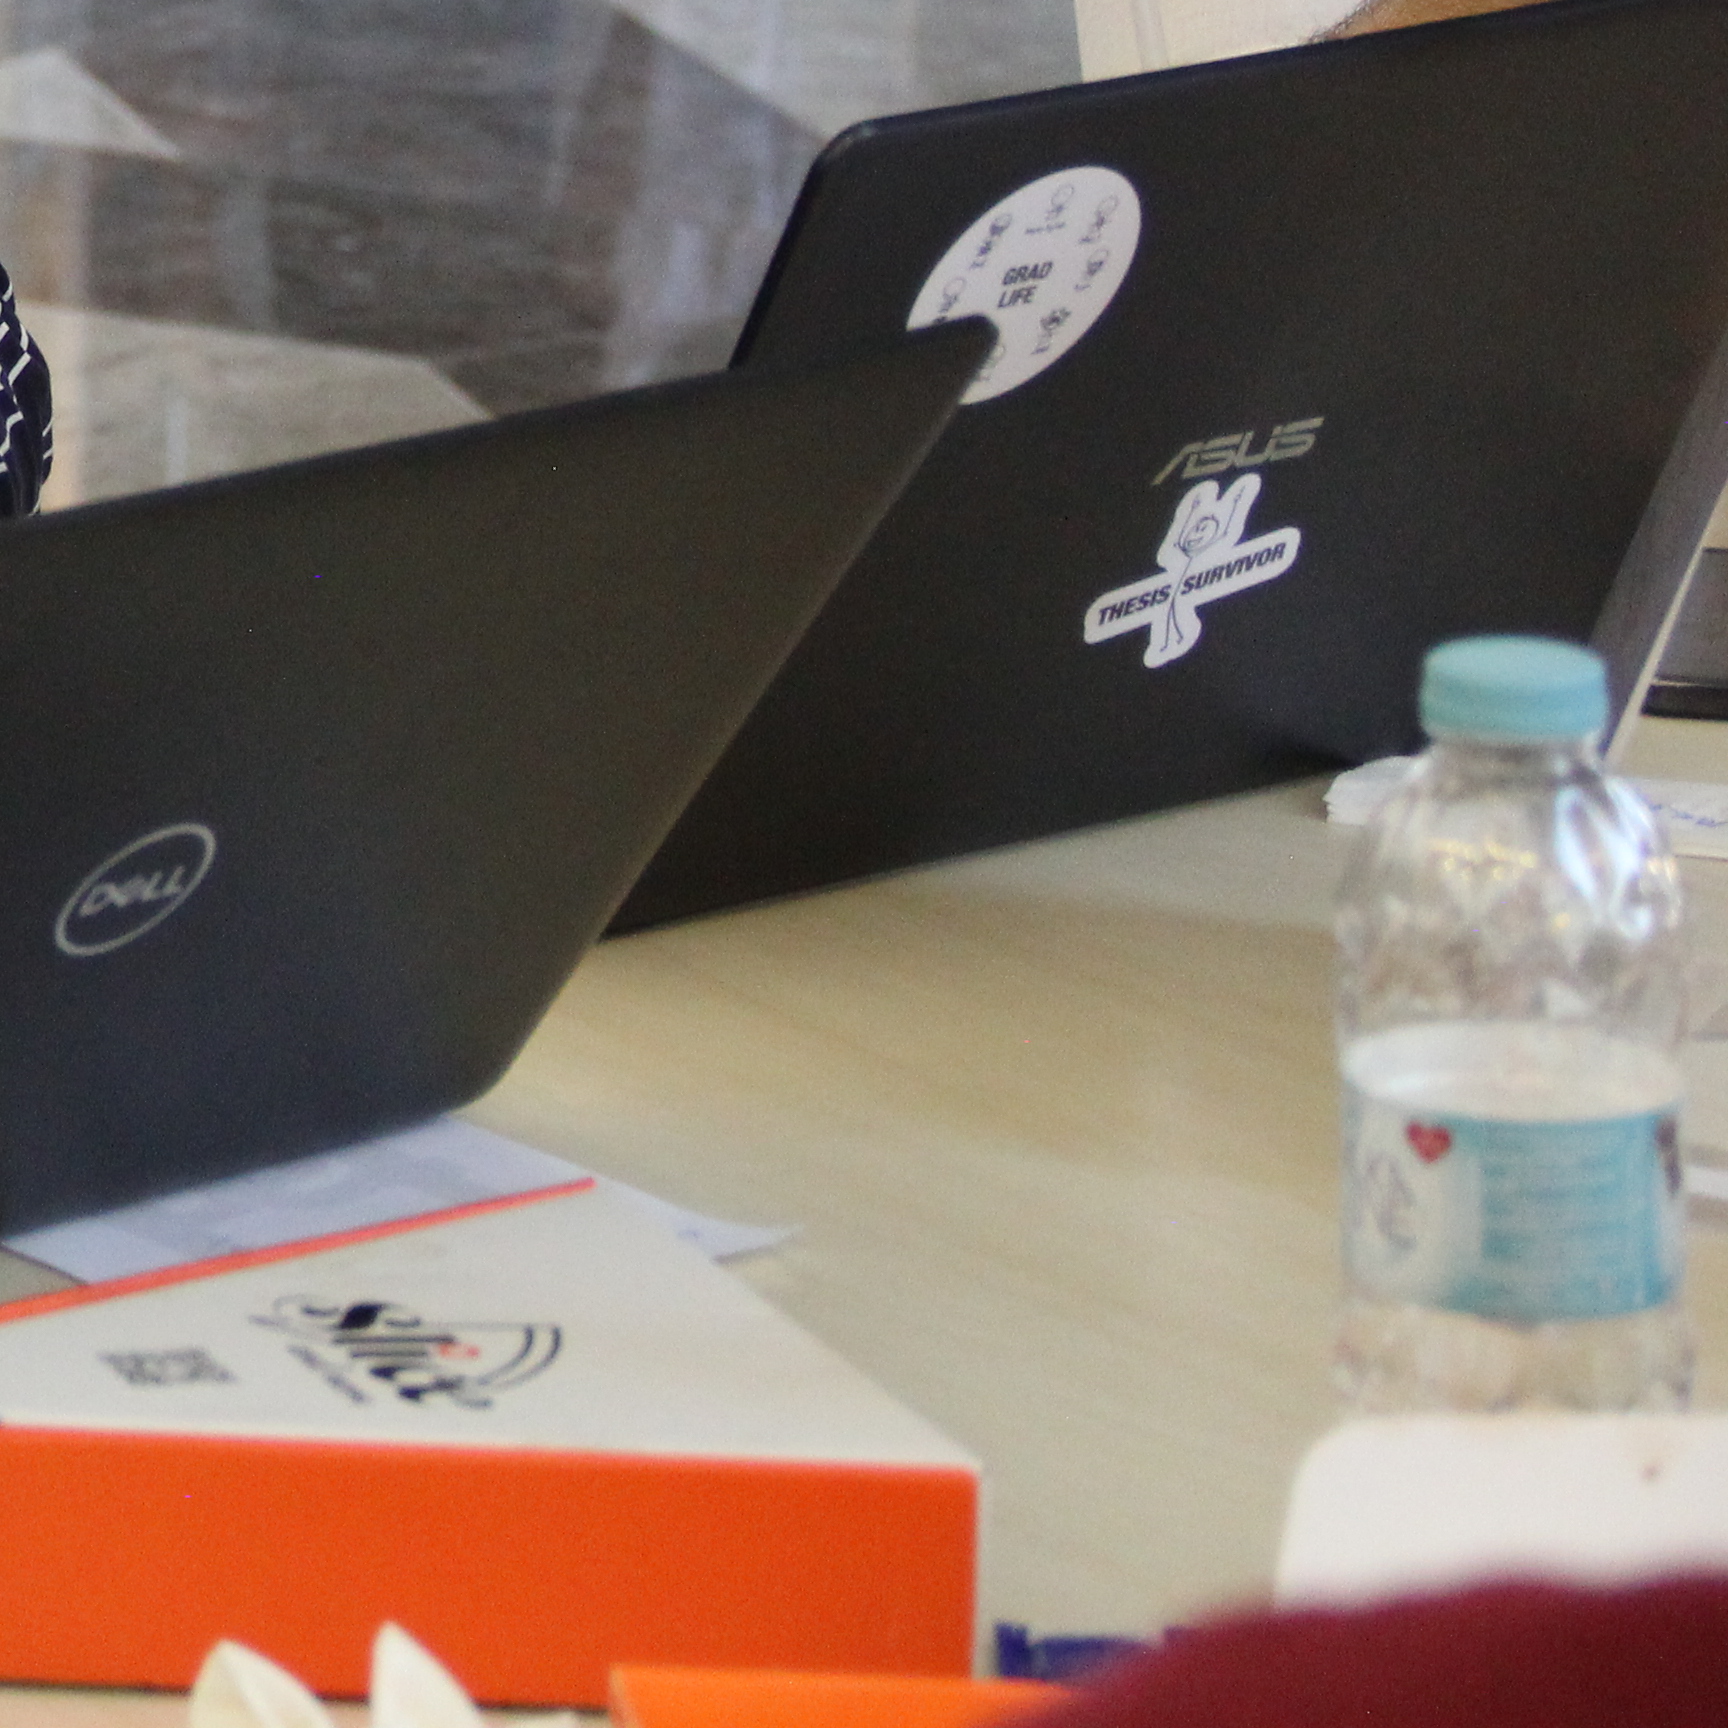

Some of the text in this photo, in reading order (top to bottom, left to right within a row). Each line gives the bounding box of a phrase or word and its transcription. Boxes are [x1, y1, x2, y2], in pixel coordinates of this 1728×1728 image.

[996, 285, 1038, 310] LIFE
[1001, 261, 1054, 287] GRAD
[1151, 415, 1325, 487] ASUS
[1098, 541, 1287, 626] THESIS SURVIVOR
[78, 864, 186, 917] DELL
